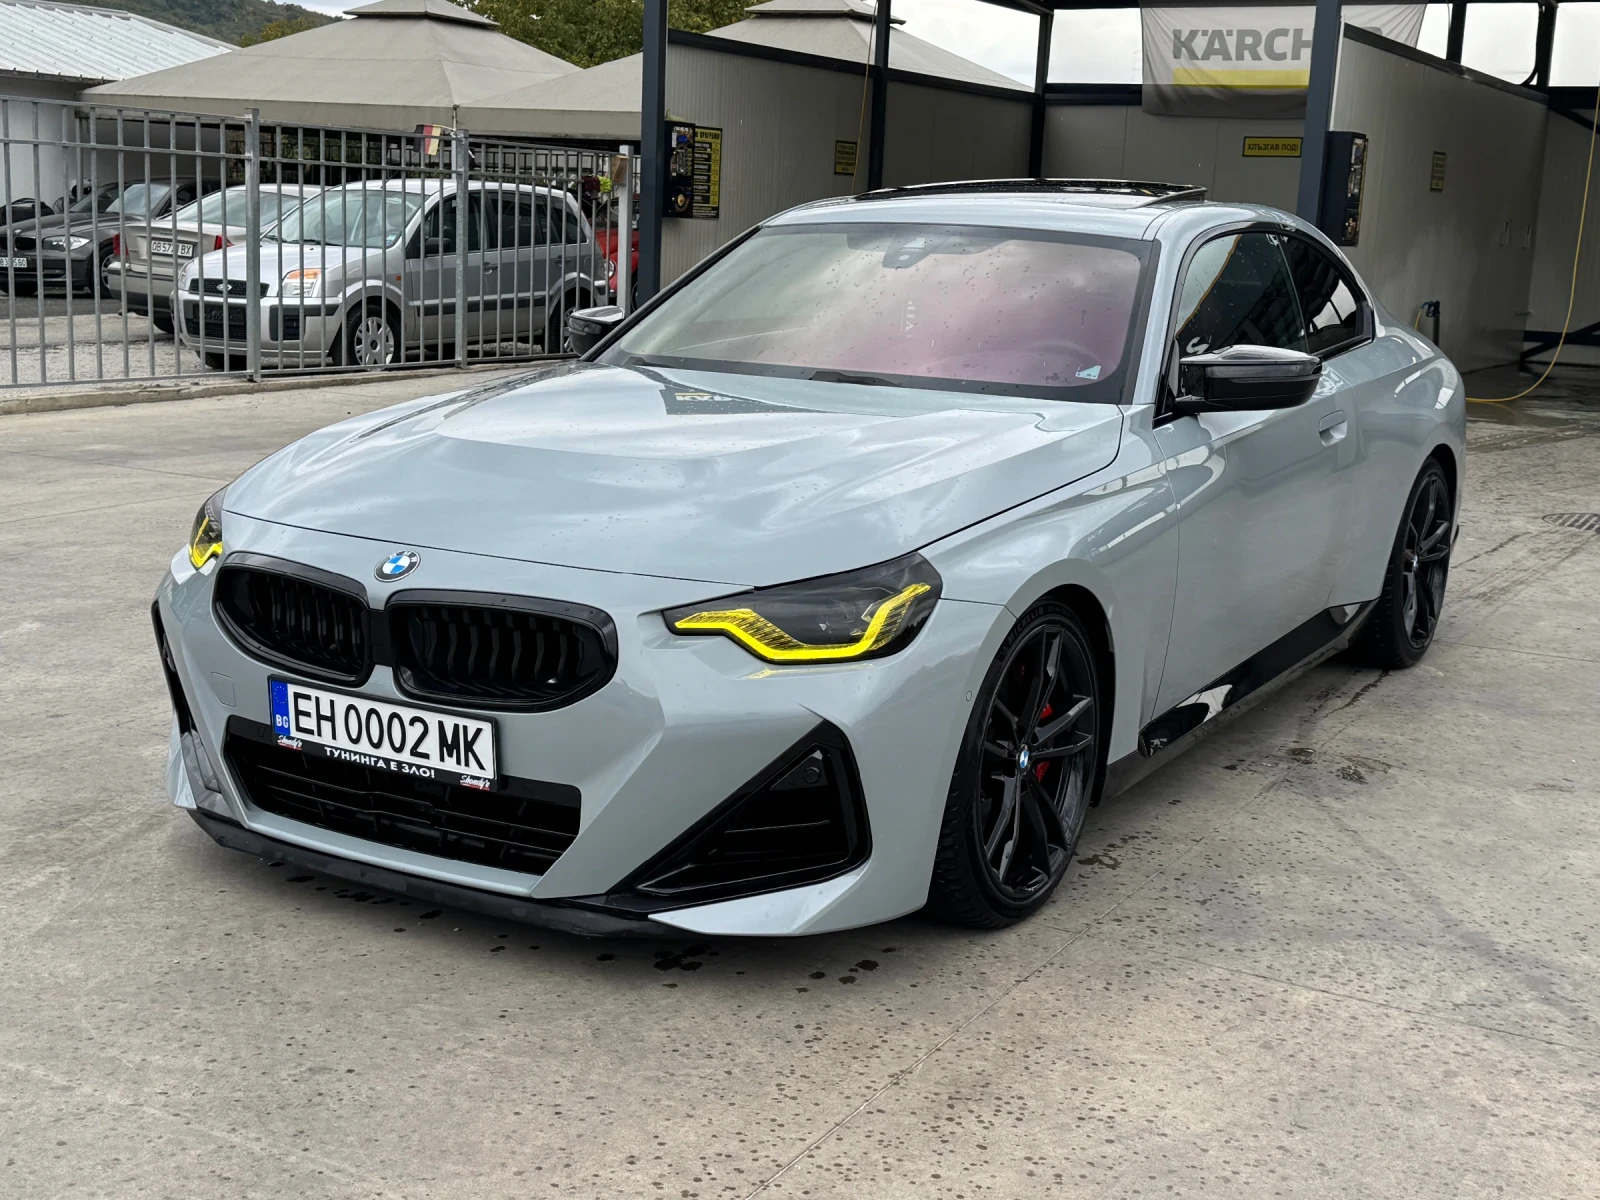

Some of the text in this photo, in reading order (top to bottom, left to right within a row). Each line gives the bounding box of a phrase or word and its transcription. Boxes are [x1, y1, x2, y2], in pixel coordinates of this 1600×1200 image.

[1172, 27, 1383, 62] KÄRCH
[1247, 143, 1279, 151] ХЛЪЗГАВ
[275, 714, 289, 729] BG
[344, 703, 430, 760] 0002
[324, 746, 387, 769] ТУНИНГА
[401, 763, 435, 779] ЗЛО!
